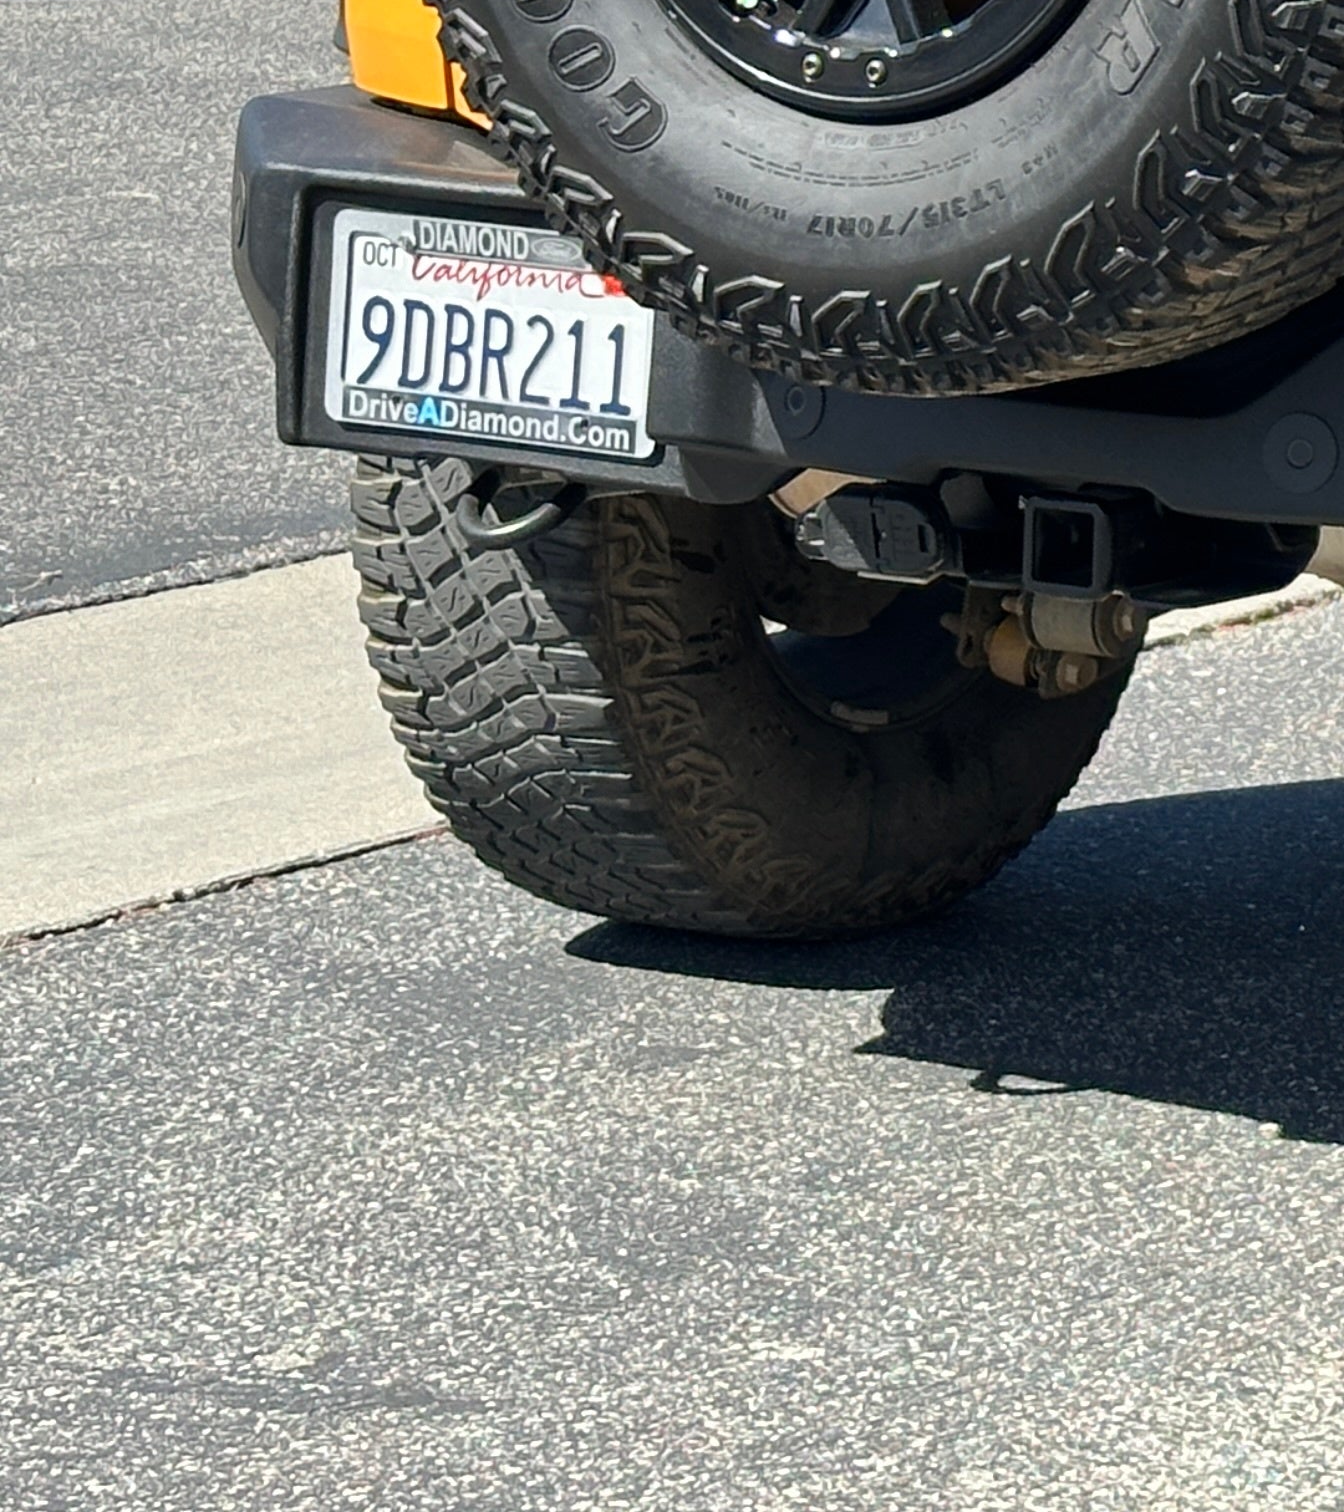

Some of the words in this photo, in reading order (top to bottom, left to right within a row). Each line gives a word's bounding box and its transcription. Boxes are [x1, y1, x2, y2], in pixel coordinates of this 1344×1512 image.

[806, 178, 1006, 239] LT315/70R17
[362, 240, 402, 268] OCT
[419, 221, 529, 260] DIAMOND
[411, 254, 604, 302] California
[356, 294, 632, 416] 9DBR211
[349, 389, 631, 451] DriveADiamond.Com
